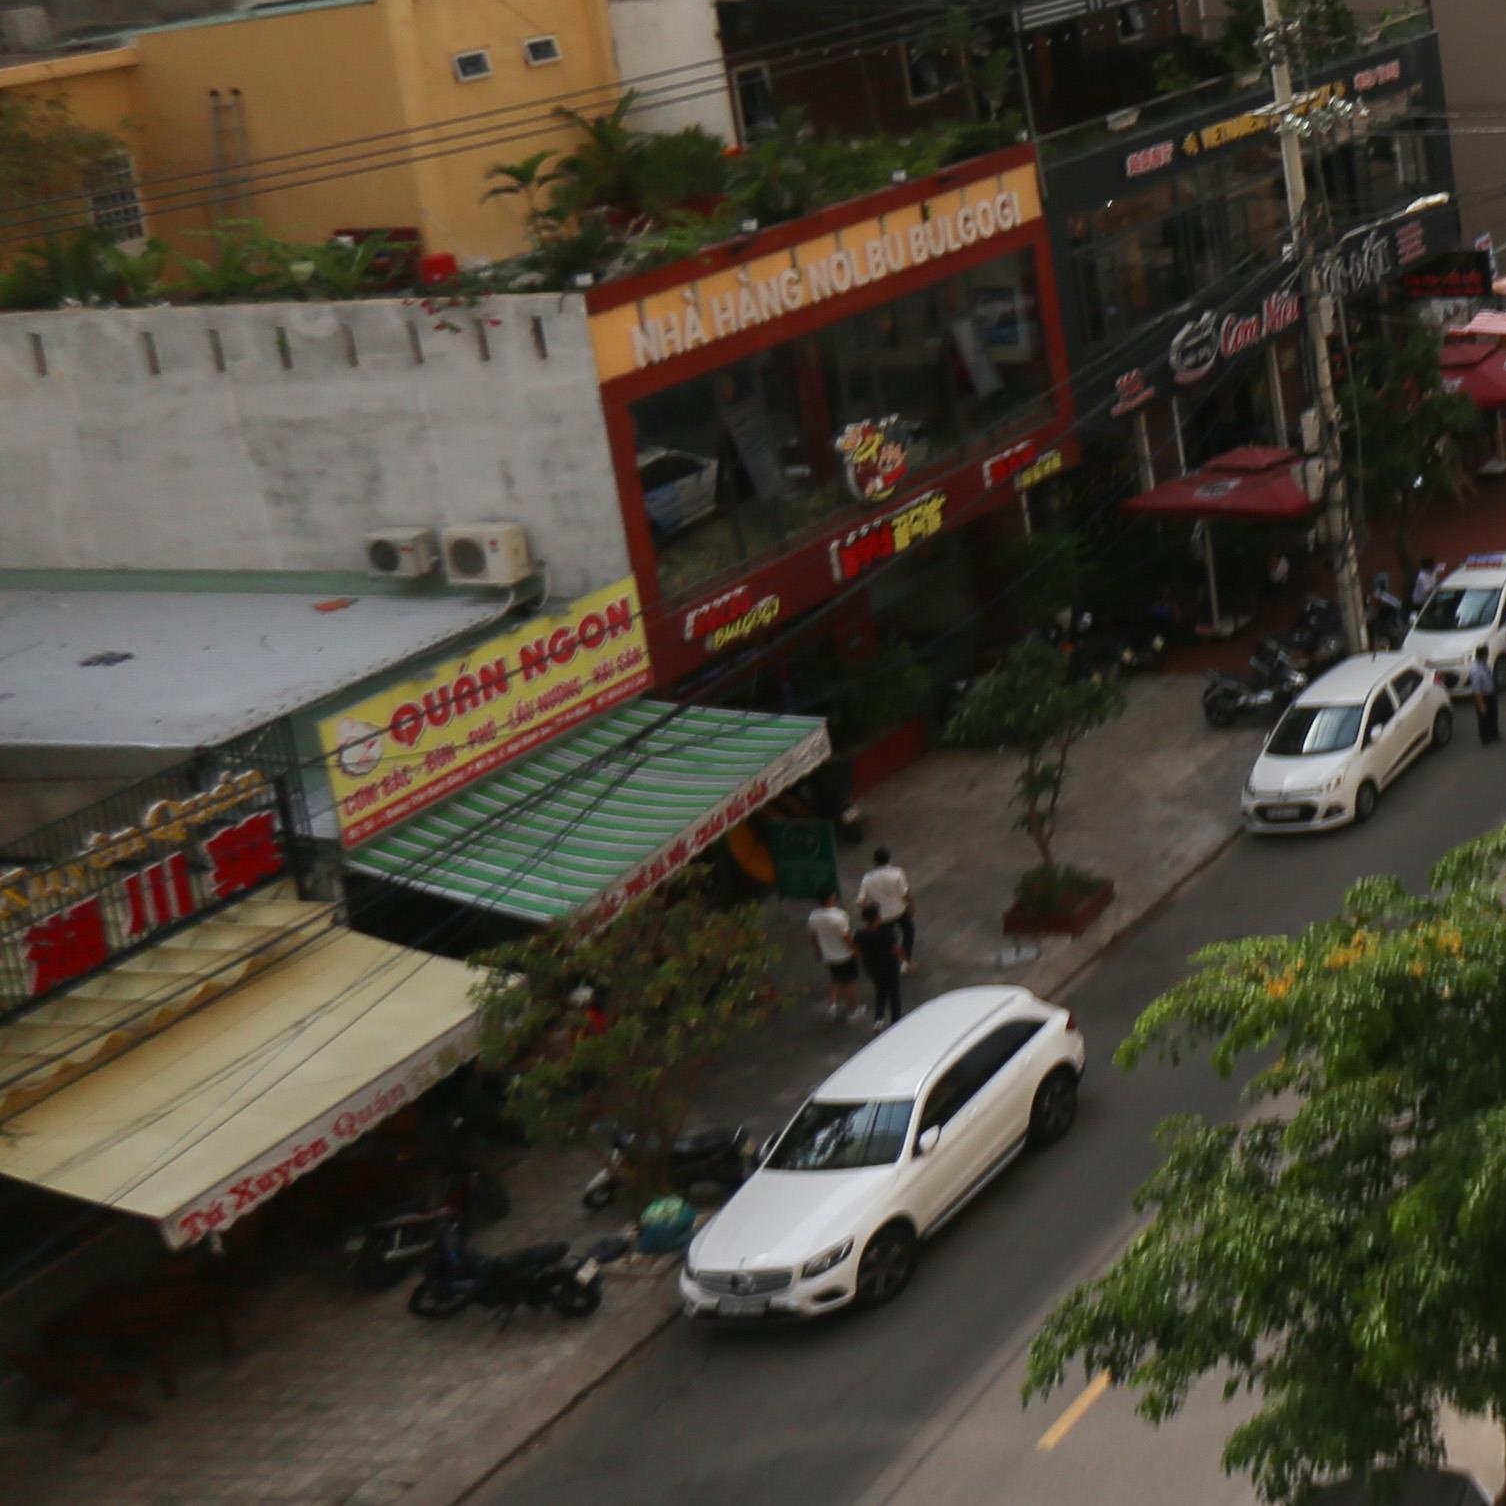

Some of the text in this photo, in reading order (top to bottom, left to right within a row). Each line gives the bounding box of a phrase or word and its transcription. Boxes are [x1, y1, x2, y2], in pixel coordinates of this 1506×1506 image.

[631, 288, 708, 370] NHÀ
[712, 268, 804, 339] HÀNG
[908, 192, 1022, 265] BULGOGI
[390, 657, 509, 747] QUÁN
[519, 596, 633, 683] NGON
[228, 1135, 330, 1212] Xuyên
[332, 1082, 408, 1142] Quán
